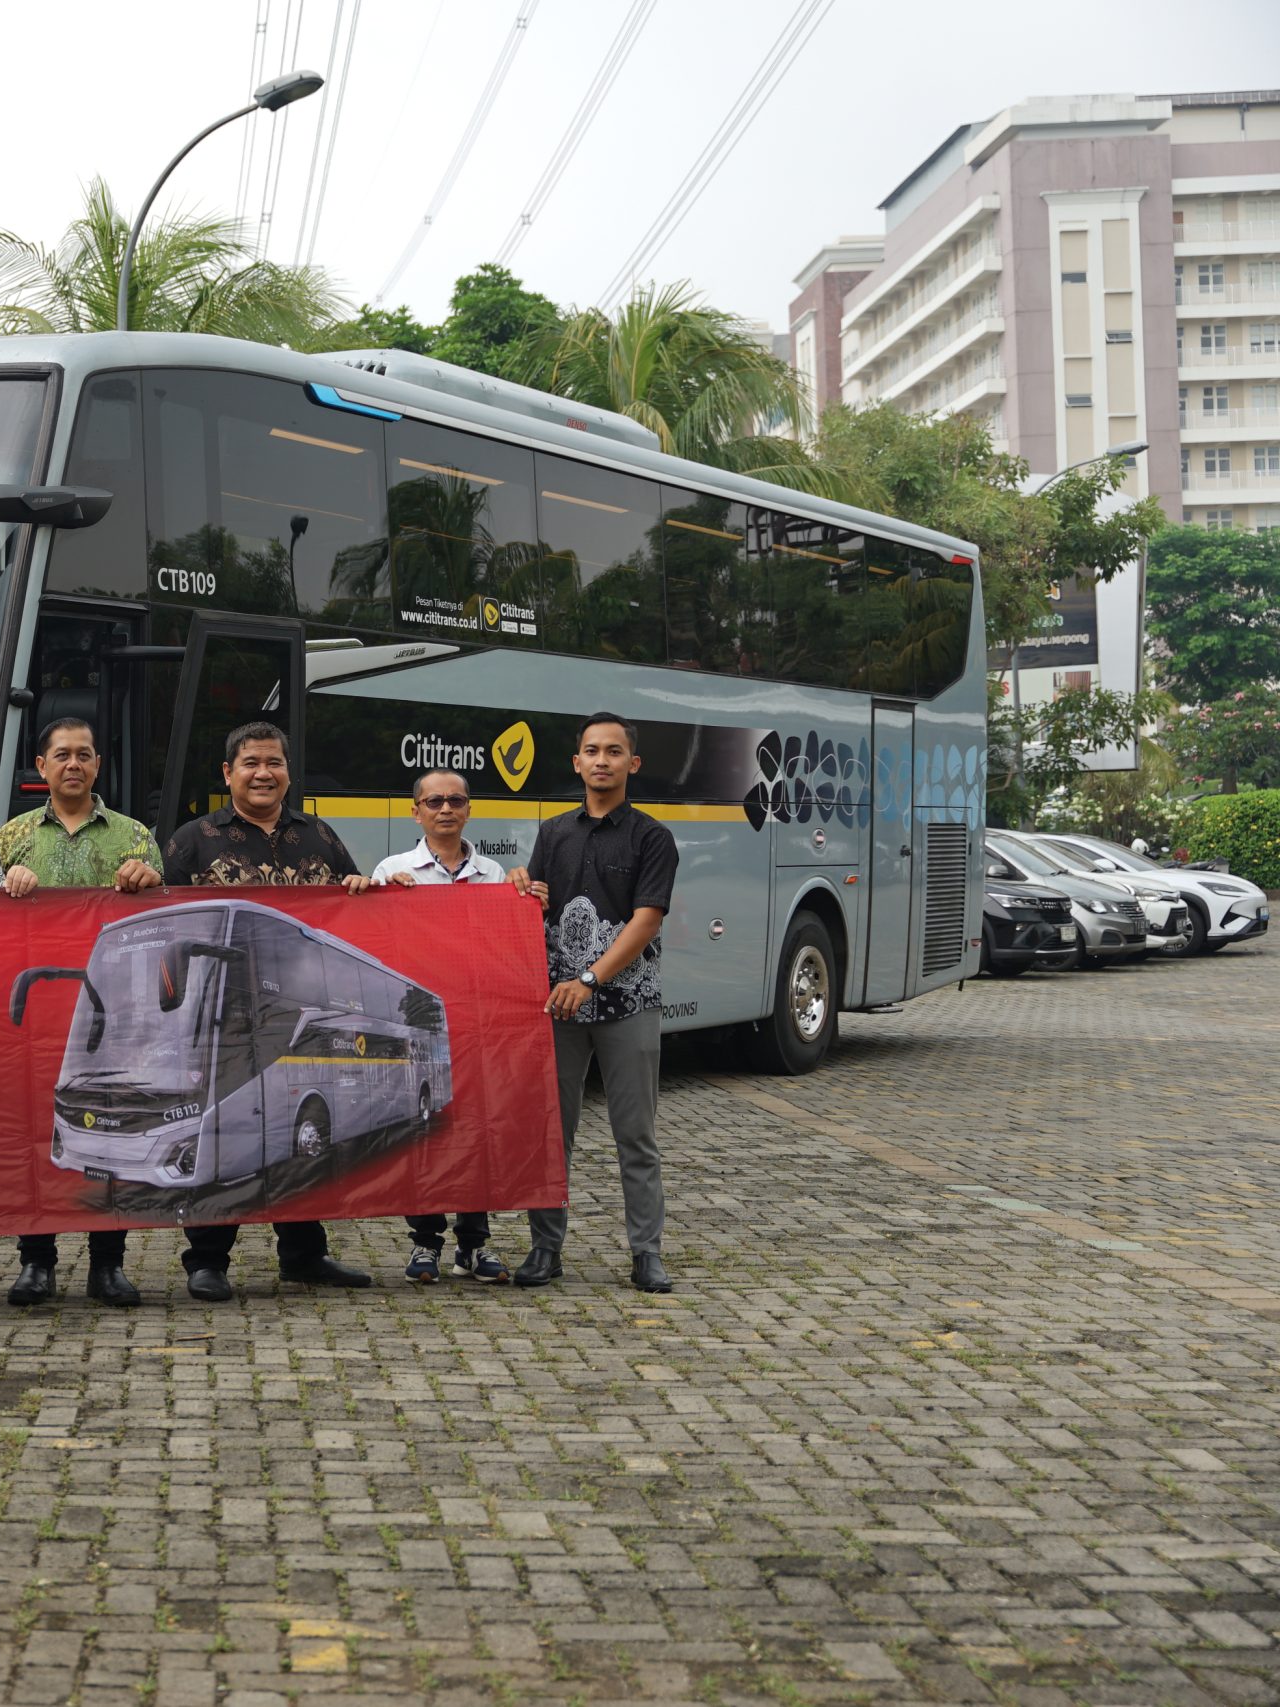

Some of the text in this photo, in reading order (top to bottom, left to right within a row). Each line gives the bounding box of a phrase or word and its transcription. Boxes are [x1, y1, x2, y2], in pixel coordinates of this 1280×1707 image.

[158, 567, 216, 596] CTB109
[415, 595, 464, 611] Pesan Tiketnya di
[500, 603, 535, 620] Cititrans
[401, 610, 478, 630] www.cititrans.co.id
[400, 733, 485, 771] Cititrans
[480, 838, 517, 855] Nusabird
[660, 1000, 698, 1020] ROVINSI
[96, 1116, 121, 1127] Cititrans
[163, 1102, 201, 1122] CTB112
